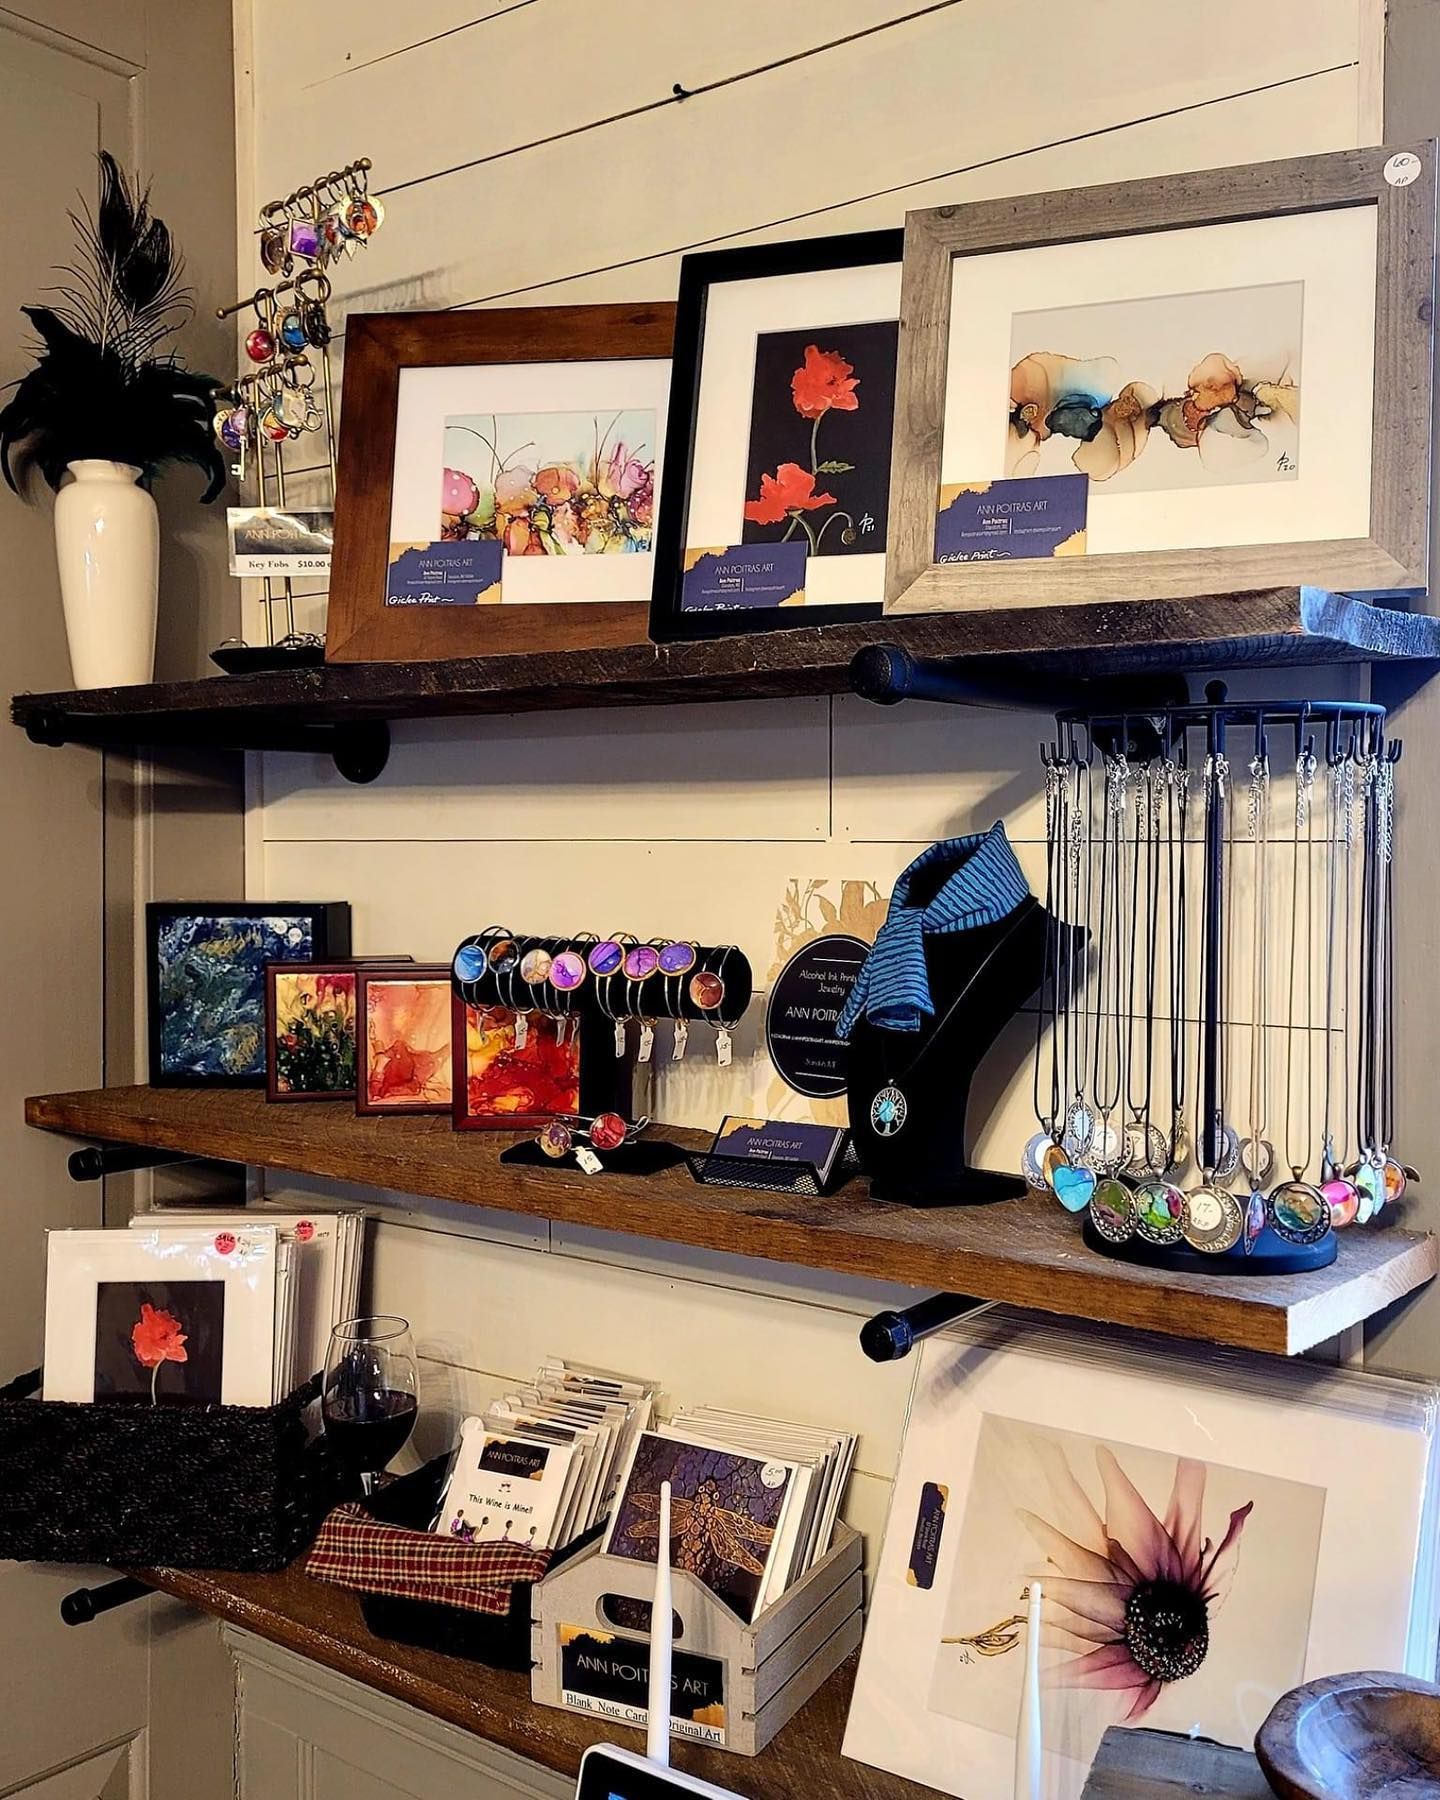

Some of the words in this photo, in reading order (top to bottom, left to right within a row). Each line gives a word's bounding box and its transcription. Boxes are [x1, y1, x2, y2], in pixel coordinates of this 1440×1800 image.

[976, 504, 995, 516] ANN
[996, 501, 1032, 514] POITRAS
[1033, 500, 1048, 511] ART
[248, 560, 265, 570] Key
[268, 560, 290, 568] Fobs
[297, 560, 326, 568] $10.00
[418, 559, 433, 569] ANN
[433, 558, 461, 568] POITRAS
[461, 558, 473, 567] ART
[714, 566, 730, 575] ANN
[730, 563, 761, 574] POITRAS
[761, 563, 774, 572] ART
[799, 969, 826, 981] Alcohol
[818, 982, 846, 996] Jewelry
[785, 1006, 810, 1019] ANN
[747, 1137, 762, 1146] ANN
[761, 1139, 790, 1149] POITRAS
[789, 1141, 803, 1150] ART
[486, 1450, 501, 1460] ANN
[500, 1452, 529, 1466] POITRAS
[528, 1458, 541, 1468] ART
[469, 1493, 483, 1504] This
[485, 1496, 502, 1509] Wine
[504, 1501, 511, 1510] is
[576, 1653, 608, 1674] ANN
[611, 1662, 679, 1691] POITS
[682, 1679, 709, 1697] ART
[566, 1693, 593, 1709] Blank
[598, 1701, 620, 1716] Note
[704, 1728, 721, 1742] Art
